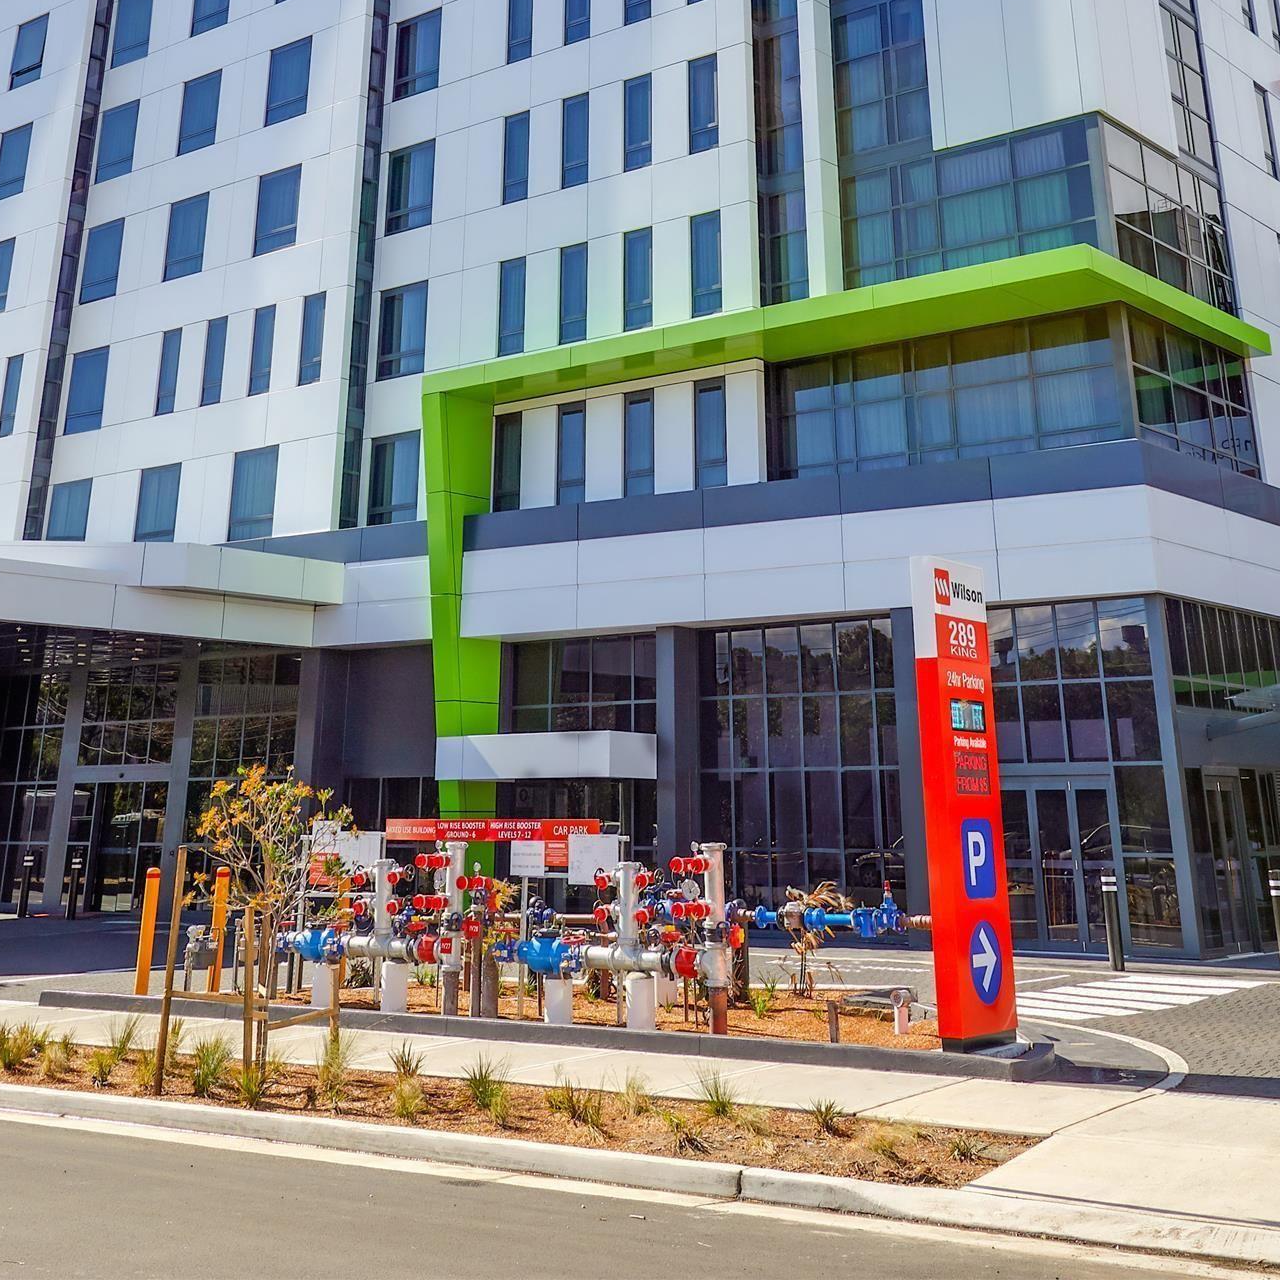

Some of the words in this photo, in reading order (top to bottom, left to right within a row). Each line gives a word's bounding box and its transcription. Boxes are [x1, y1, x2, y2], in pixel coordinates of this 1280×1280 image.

[950, 581, 983, 604] Wilson
[948, 619, 977, 649] 289
[950, 646, 978, 660] KING
[946, 670, 962, 689] 24hr
[961, 671, 985, 694] Parking
[412, 826, 436, 834] BUILDING
[449, 821, 461, 829] RISE
[489, 821, 503, 829] HIGH
[503, 821, 516, 829] RISE
[516, 821, 541, 829] BOOSTER
[553, 825, 568, 836] CAR
[569, 825, 589, 835] PARK
[498, 831, 517, 839] LEVELS
[967, 830, 986, 887] P
